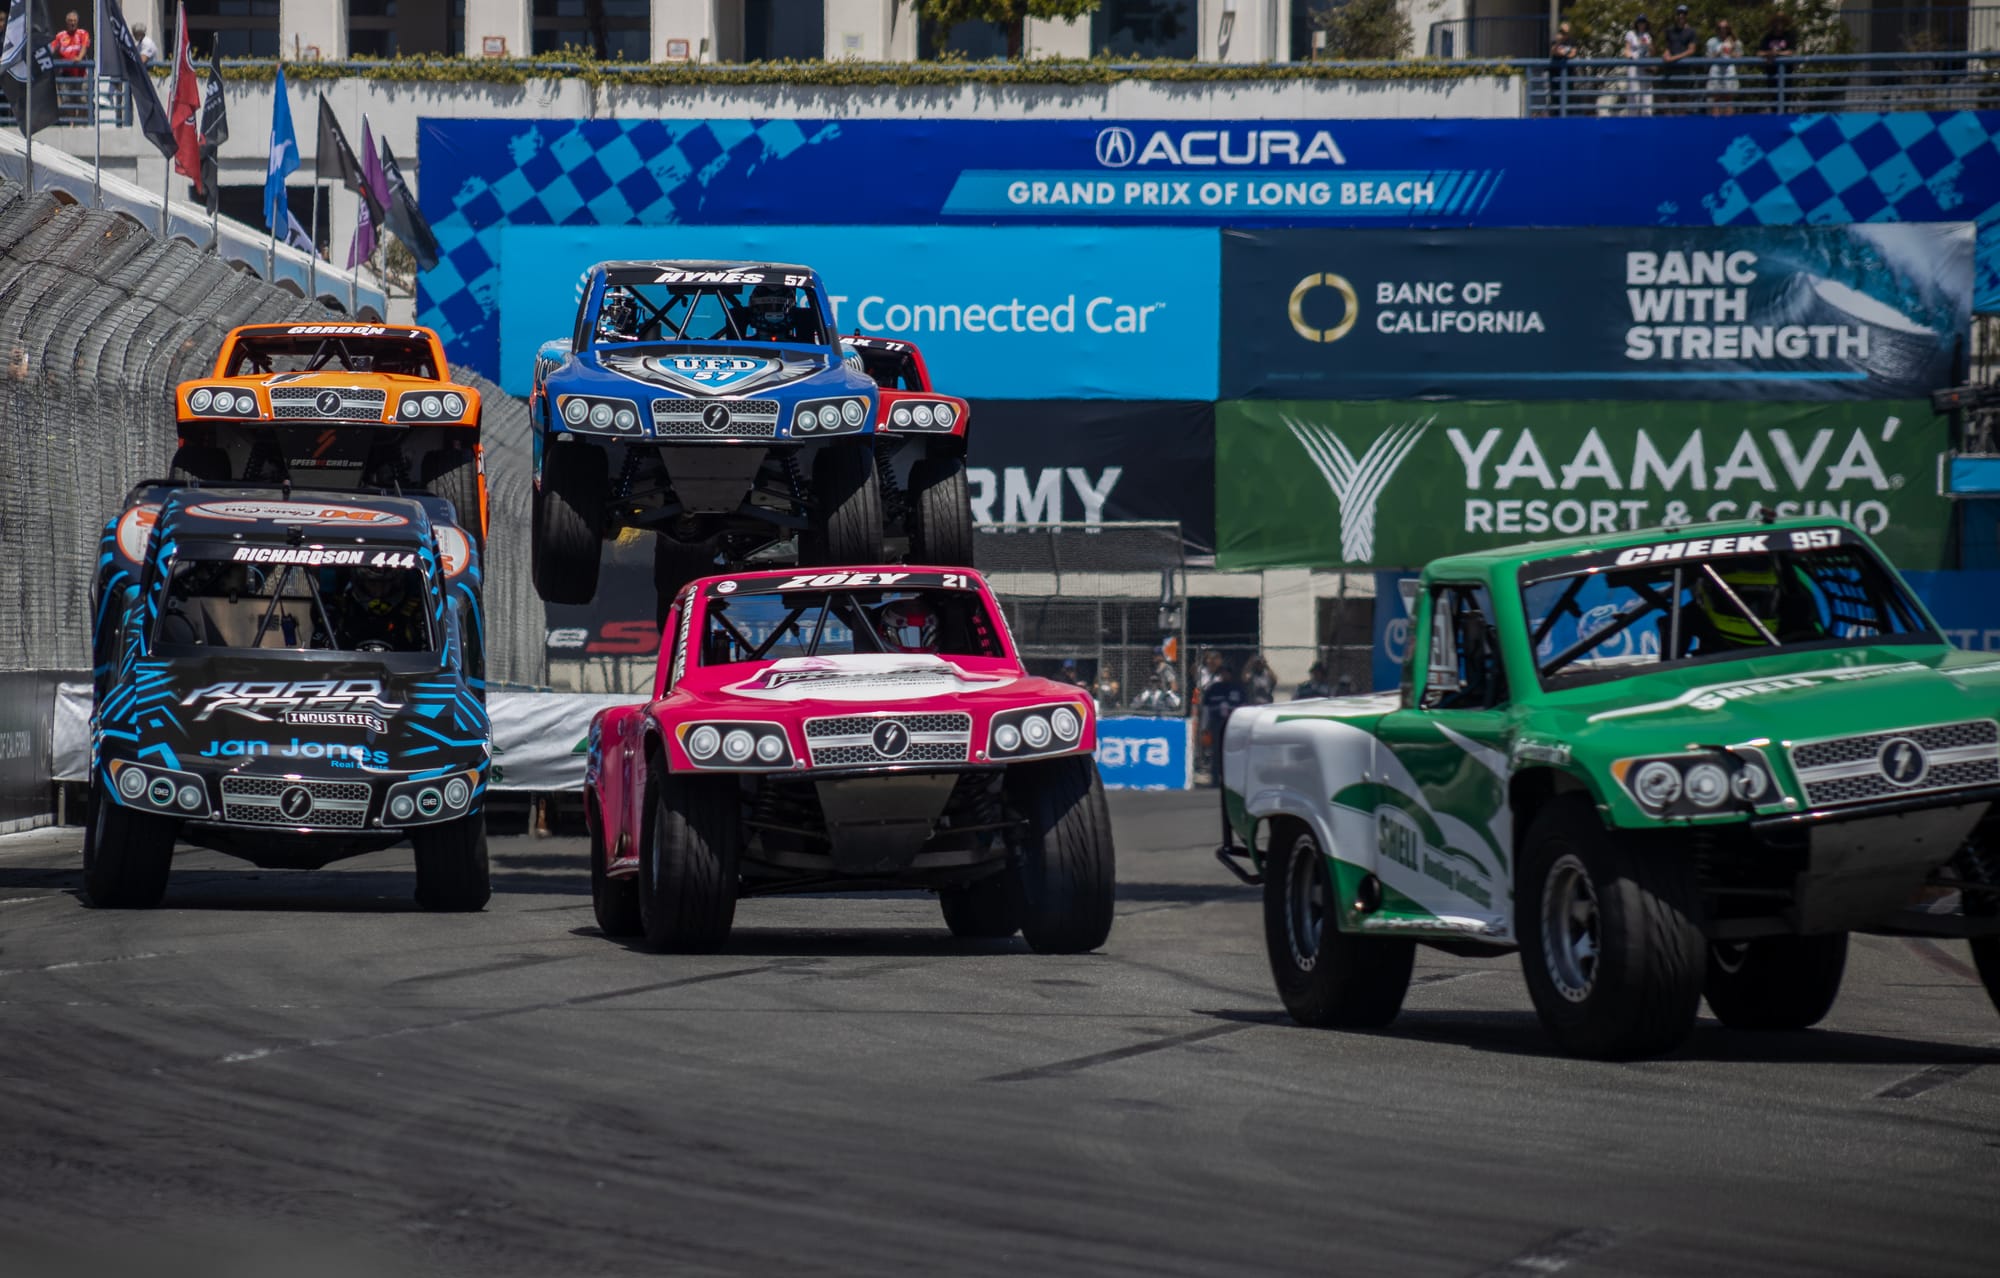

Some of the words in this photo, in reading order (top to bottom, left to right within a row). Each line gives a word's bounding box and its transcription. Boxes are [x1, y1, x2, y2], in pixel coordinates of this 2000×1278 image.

[1136, 131, 1346, 165] ACURA
[1007, 182, 1116, 205] GRAND
[1124, 182, 1191, 205] PRIX
[1199, 182, 1240, 206] OF
[1246, 181, 1331, 205] LONG
[1339, 181, 1435, 204] BEACH
[654, 272, 766, 283] HYNES
[784, 275, 808, 286] 57
[1626, 251, 1758, 285] BANC
[1376, 282, 1455, 304] BANC
[1461, 281, 1502, 304] OF
[1626, 287, 1748, 322] WITH
[857, 296, 1075, 332] Connected
[1376, 310, 1546, 334] CALIFORNIA
[287, 326, 386, 335] GORDON
[1625, 325, 1870, 360] STRENGTH
[674, 359, 757, 370] UFD
[694, 371, 735, 381] 57
[1464, 501, 1649, 534] RESORT
[1661, 501, 1692, 526] &
[233, 547, 364, 564] RICHARDSON
[371, 552, 415, 568] 444
[1615, 535, 1770, 567] CHEEK
[1789, 529, 1841, 549] 957
[778, 573, 910, 589] ZOEY
[942, 574, 967, 588] 21
[179, 680, 382, 705] ROAD
[1687, 676, 1822, 711] SHELL
[290, 713, 382, 731] INDUSTRIES
[281, 738, 390, 764] Jones
[331, 760, 354, 768] Real
